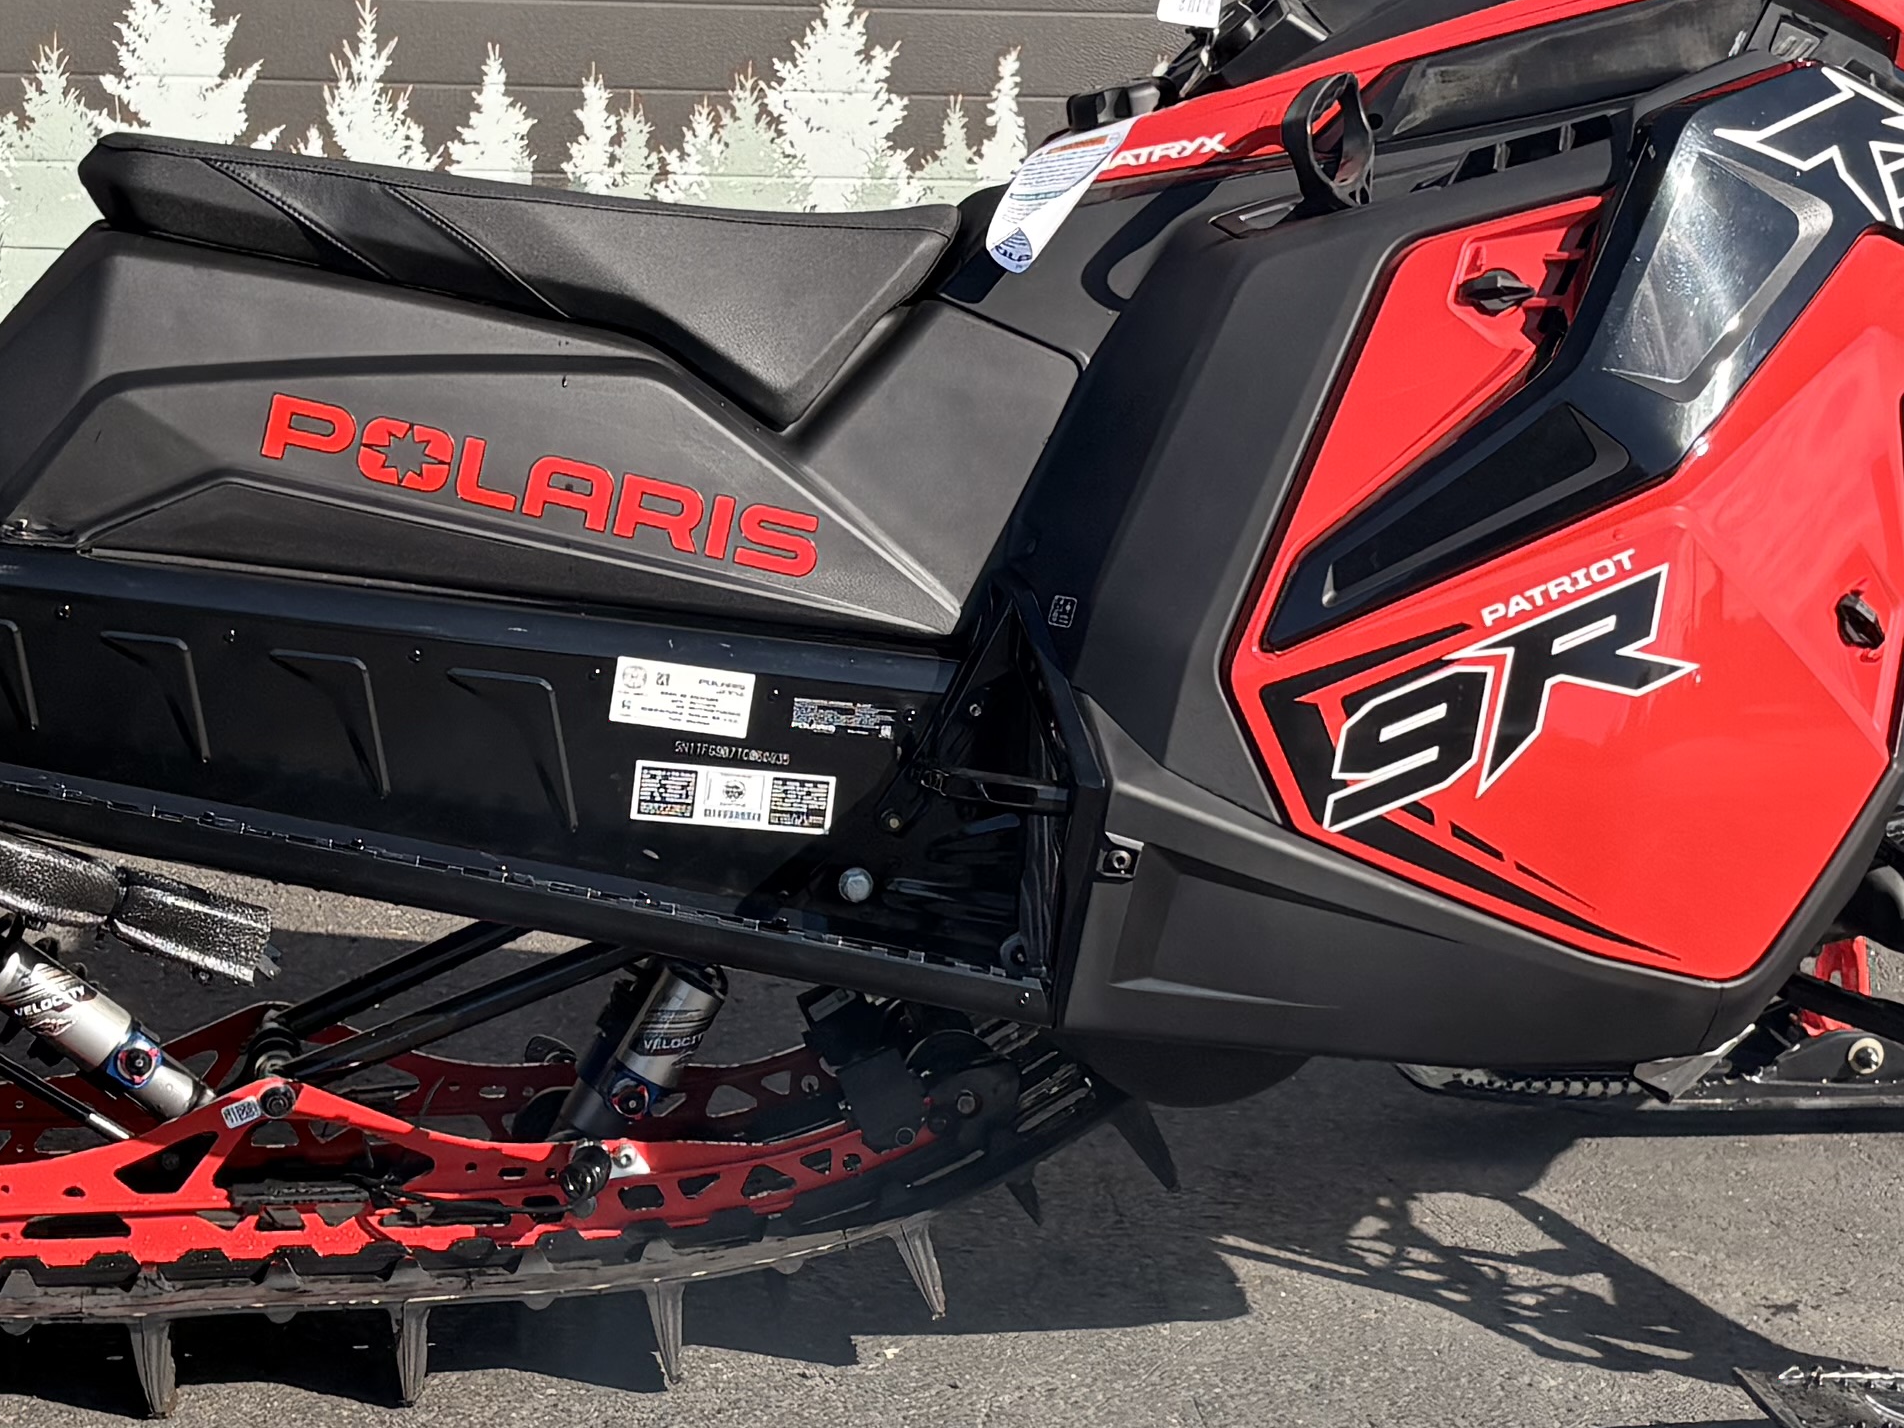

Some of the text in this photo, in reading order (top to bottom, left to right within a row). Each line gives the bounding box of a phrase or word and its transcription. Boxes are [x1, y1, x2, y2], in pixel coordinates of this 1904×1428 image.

[1109, 131, 1231, 167] ATRYX
[260, 393, 819, 577] POLARIS
[1481, 548, 1636, 627] PATRIOT
[1323, 561, 1700, 833] 9R
